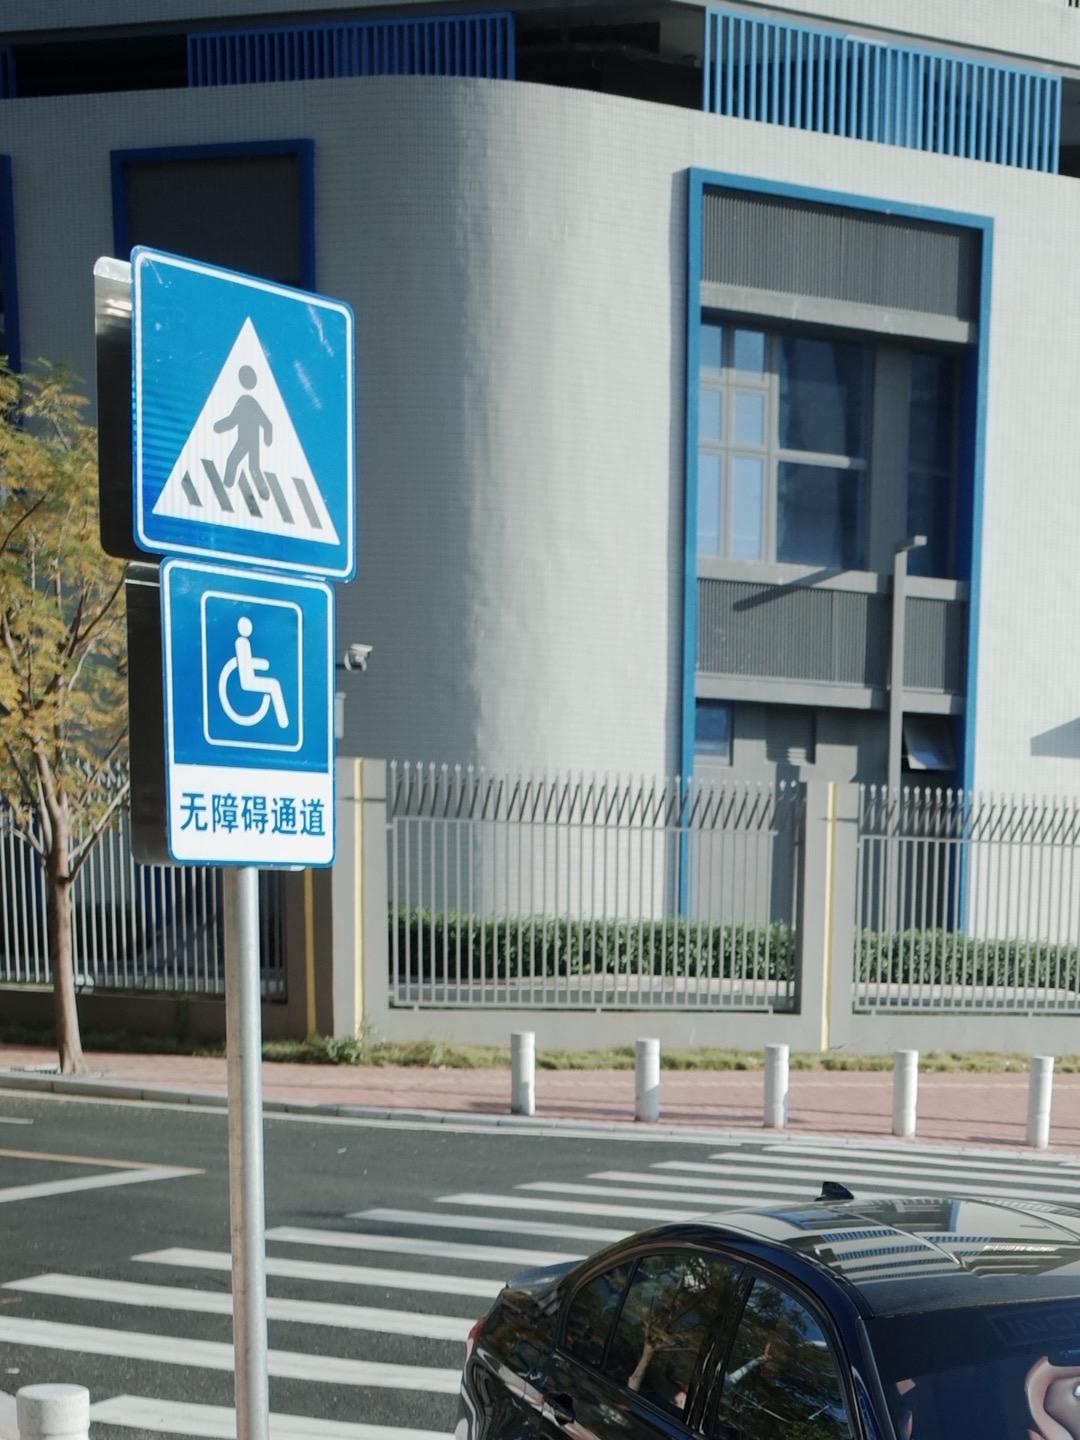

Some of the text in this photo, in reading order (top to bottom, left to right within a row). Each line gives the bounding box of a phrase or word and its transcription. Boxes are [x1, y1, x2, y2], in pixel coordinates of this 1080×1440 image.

[180, 792, 326, 836] 无障碍通道
